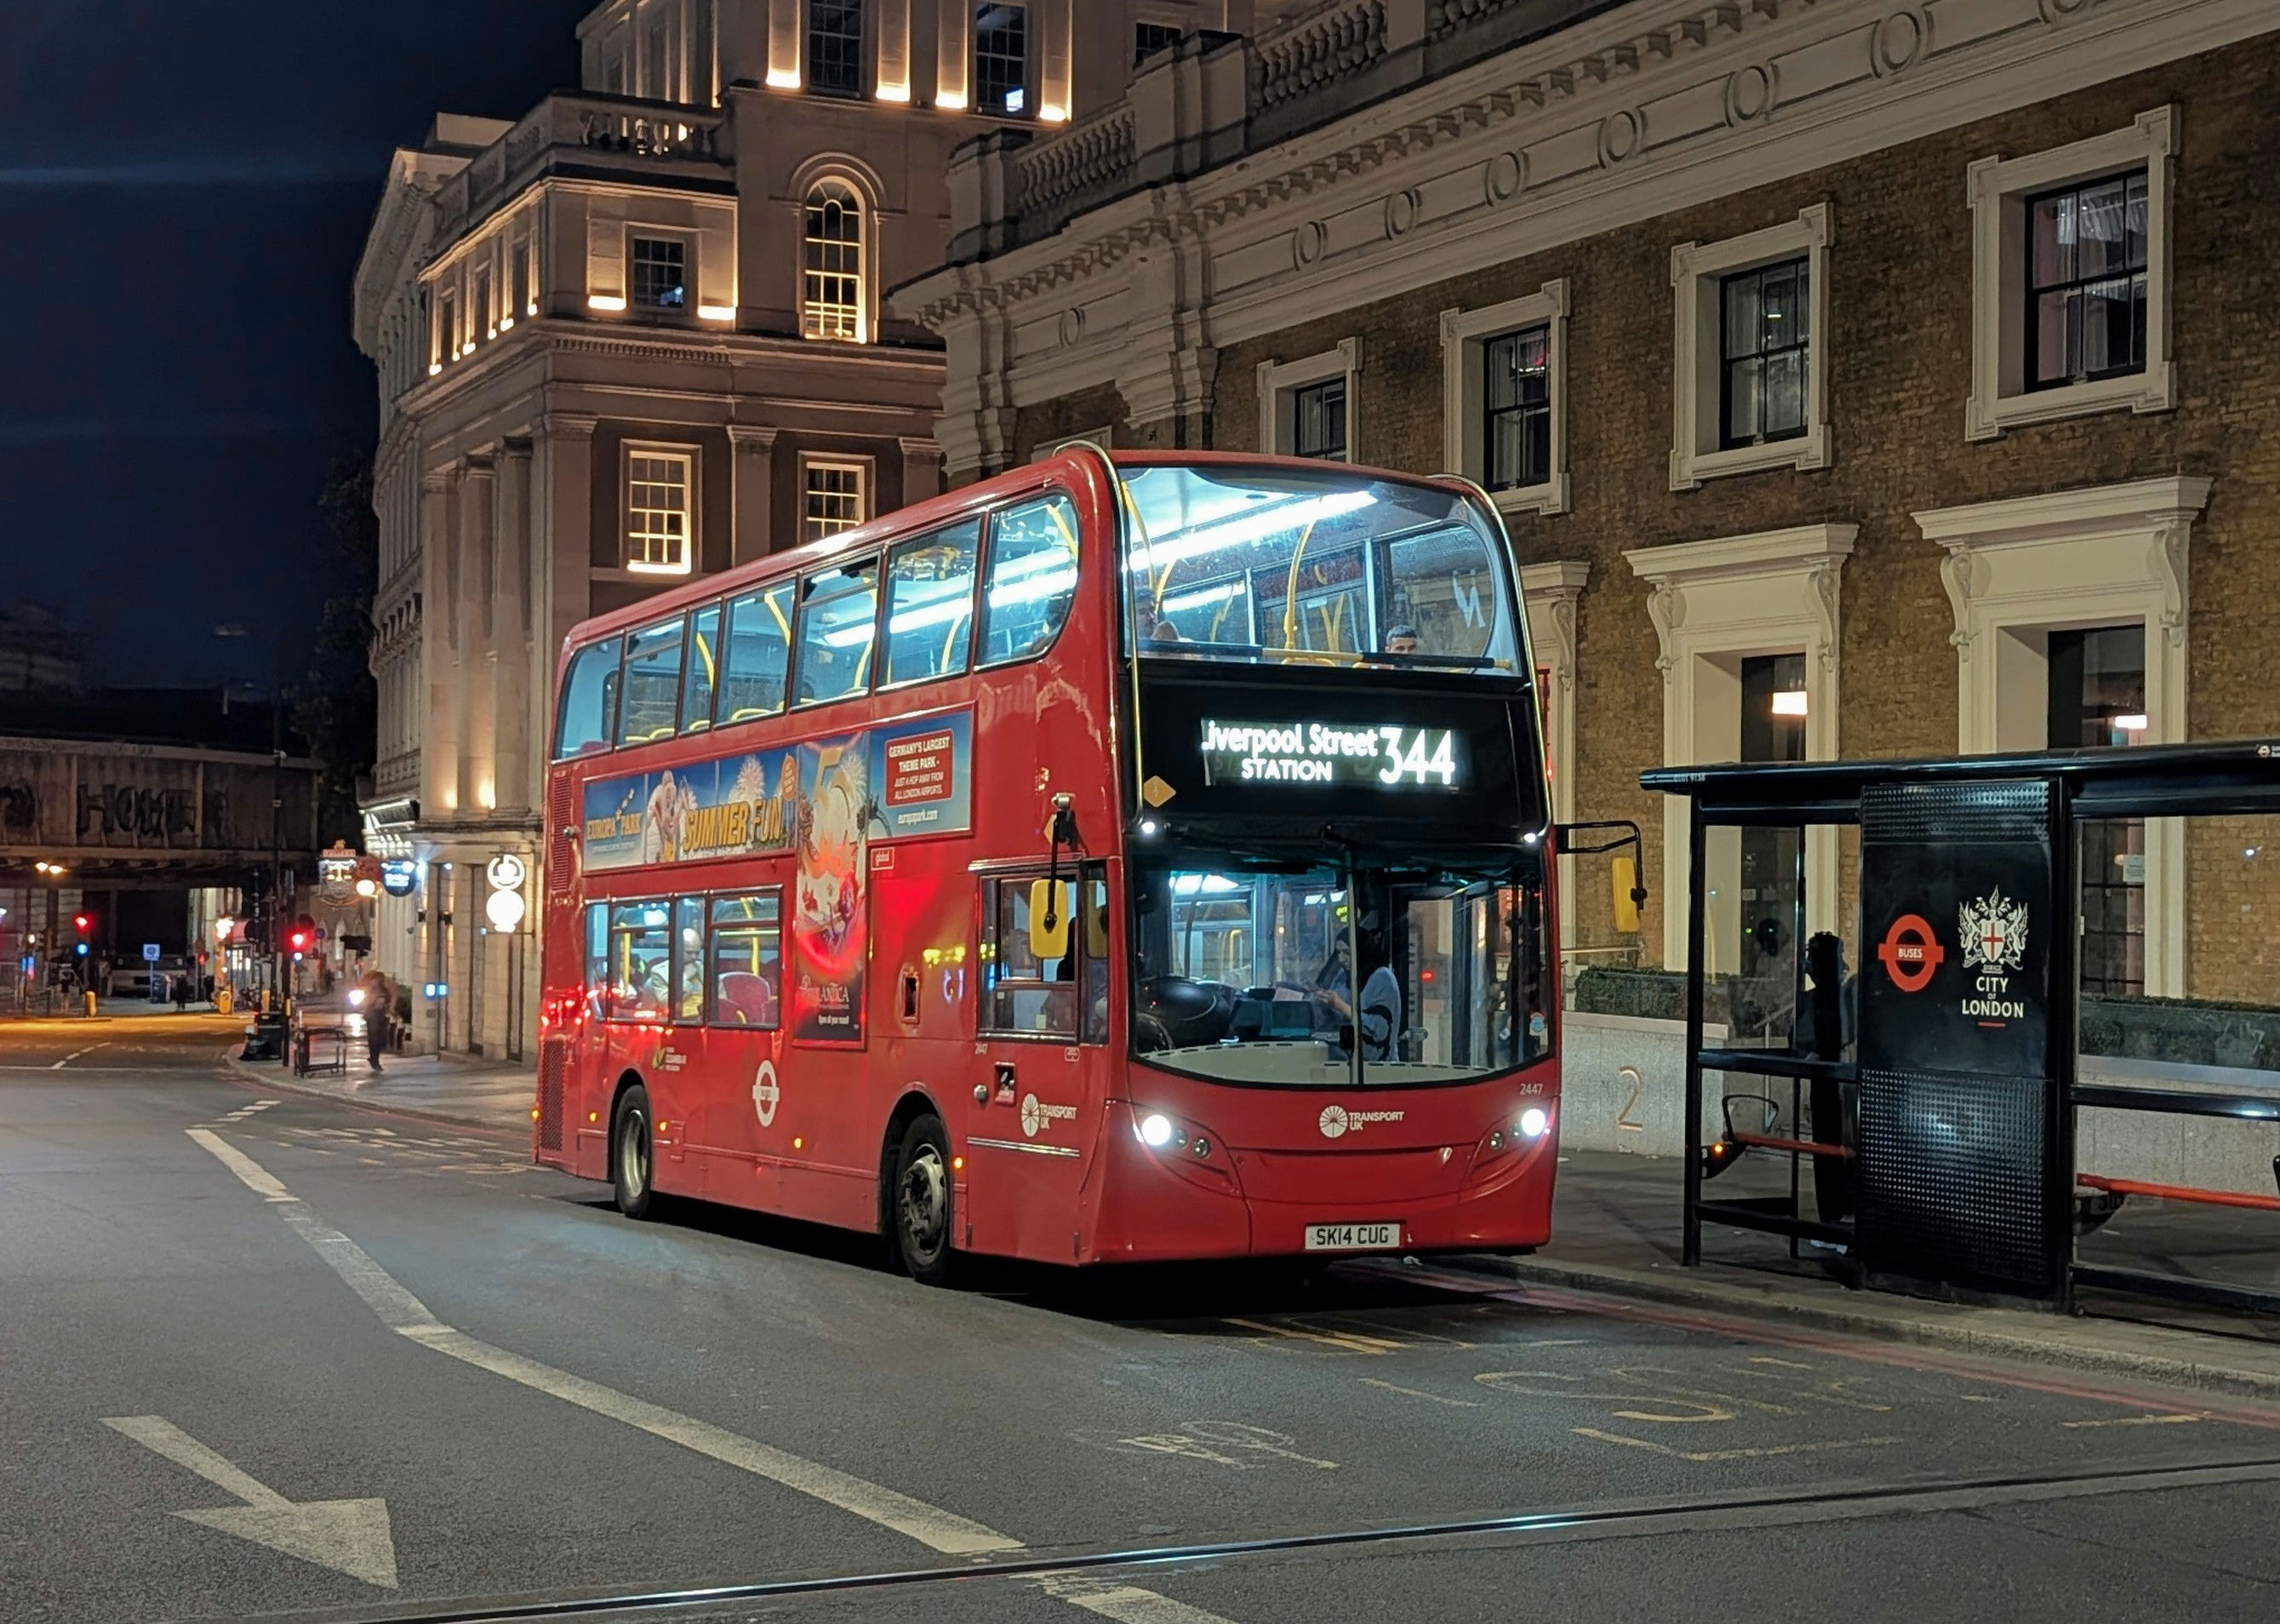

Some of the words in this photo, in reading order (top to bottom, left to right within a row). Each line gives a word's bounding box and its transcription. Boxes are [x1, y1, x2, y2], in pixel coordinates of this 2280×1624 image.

[923, 736, 950, 752] LARGEST
[1309, 723, 1379, 757] Street
[1379, 727, 1455, 784] 344
[920, 756, 936, 769] PARK
[1241, 758, 1332, 781] STATION
[683, 800, 750, 851] SUMMER
[751, 795, 782, 843] FUN
[1898, 947, 1923, 959] BUSES
[1975, 976, 2009, 993] CITY
[1962, 999, 2024, 1018] LONDON
[1519, 1083, 1544, 1095] 2447
[1618, 1066, 1643, 1131] 2
[1039, 1103, 1077, 1120] TRANSPORT
[1348, 1111, 1405, 1122] TRANSPORT
[1040, 1117, 1050, 1129] UK
[1350, 1121, 1364, 1131] UK
[1316, 1227, 1352, 1245] SK14
[1357, 1227, 1389, 1244] CUG
